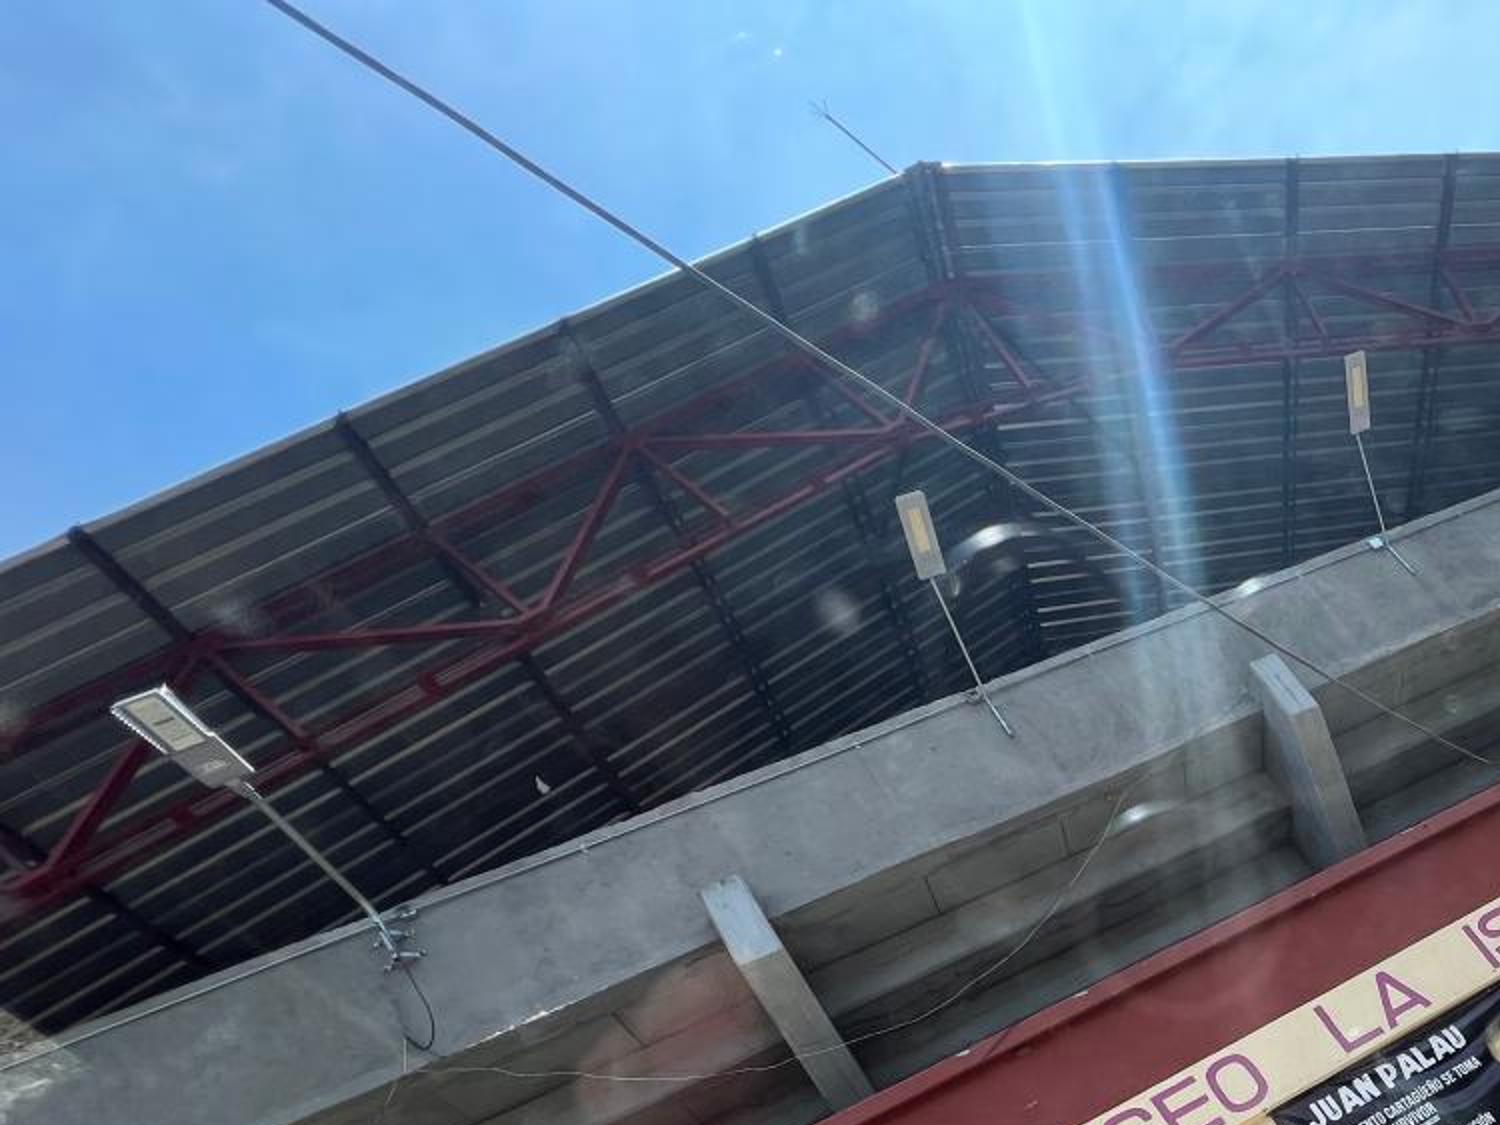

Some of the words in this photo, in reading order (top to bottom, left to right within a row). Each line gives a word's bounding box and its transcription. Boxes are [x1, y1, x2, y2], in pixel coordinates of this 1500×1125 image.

[1313, 970, 1431, 1054] LA
[1374, 1024, 1467, 1089] PALAU
[1440, 1069, 1456, 1085] SE
[1453, 1055, 1482, 1078] TOMA
